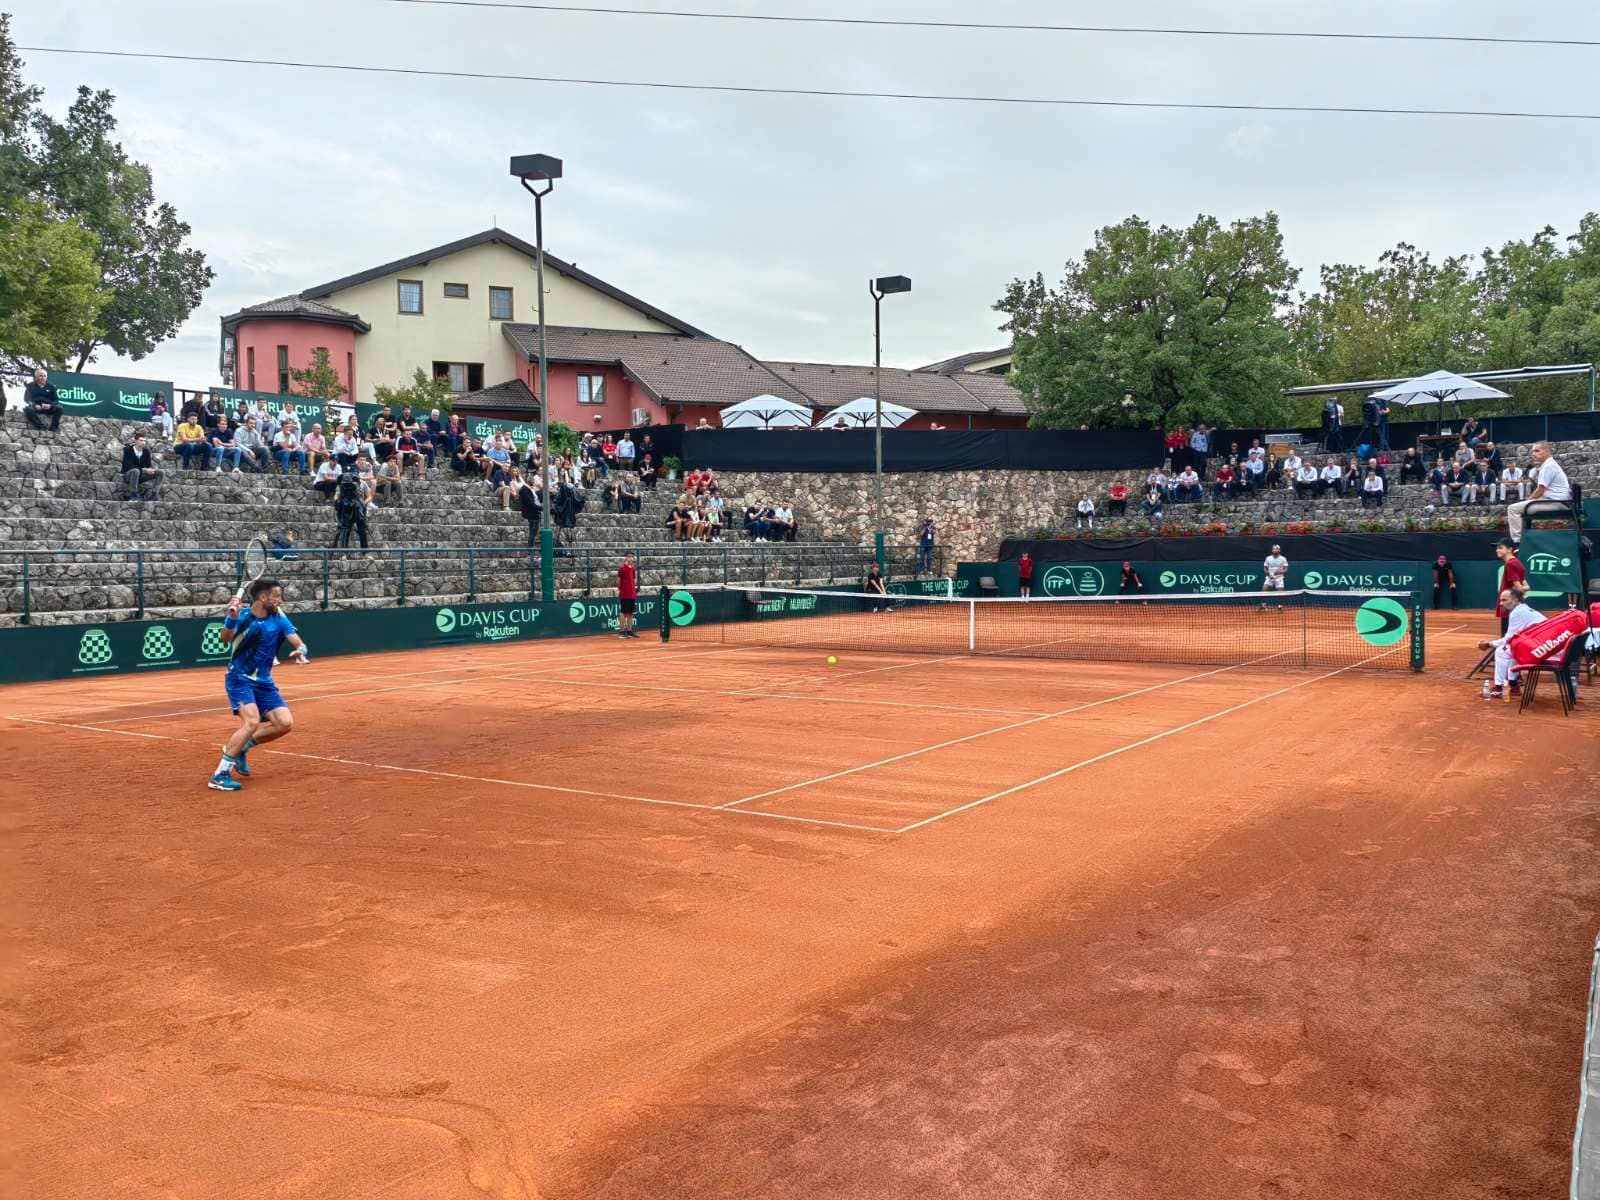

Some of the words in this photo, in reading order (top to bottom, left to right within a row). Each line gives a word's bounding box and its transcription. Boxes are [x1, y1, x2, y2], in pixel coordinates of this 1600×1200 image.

[119, 390, 154, 405] karlik
[246, 400, 286, 413] WRL
[295, 405, 320, 417] CUP
[1530, 559, 1558, 571] ITF
[921, 582, 934, 592] THE
[934, 580, 956, 591] WORD
[956, 580, 970, 589] CUP
[1180, 574, 1221, 585] DAVIS
[1225, 574, 1256, 585] CUP
[1326, 575, 1373, 586] DAVIS
[1377, 575, 1413, 586] CUP
[1200, 585, 1234, 593] Rakuten
[460, 610, 505, 626] DAVIS
[509, 608, 540, 623] CUP
[588, 604, 621, 618] DAVI
[483, 625, 520, 638] Rakuten
[1530, 629, 1573, 658] Wilson
